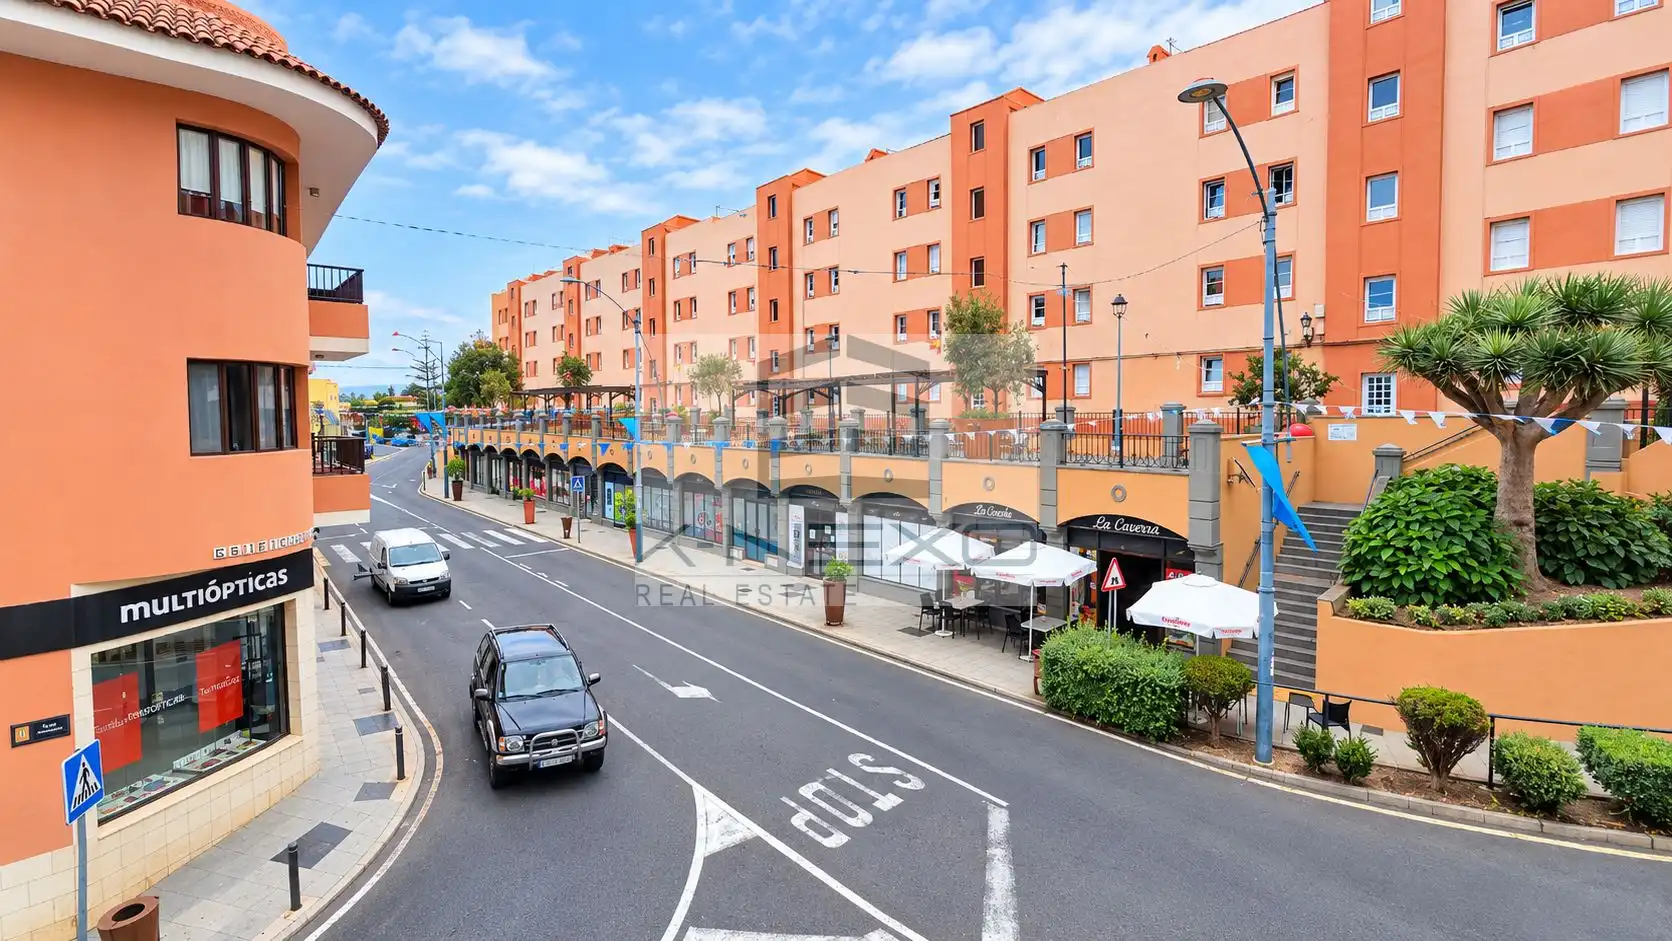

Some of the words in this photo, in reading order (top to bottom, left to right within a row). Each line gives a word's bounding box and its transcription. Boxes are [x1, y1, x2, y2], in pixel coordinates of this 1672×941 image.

[1092, 515, 1111, 530] La
[1114, 518, 1160, 535] Caverna
[781, 752, 926, 849] STOP
